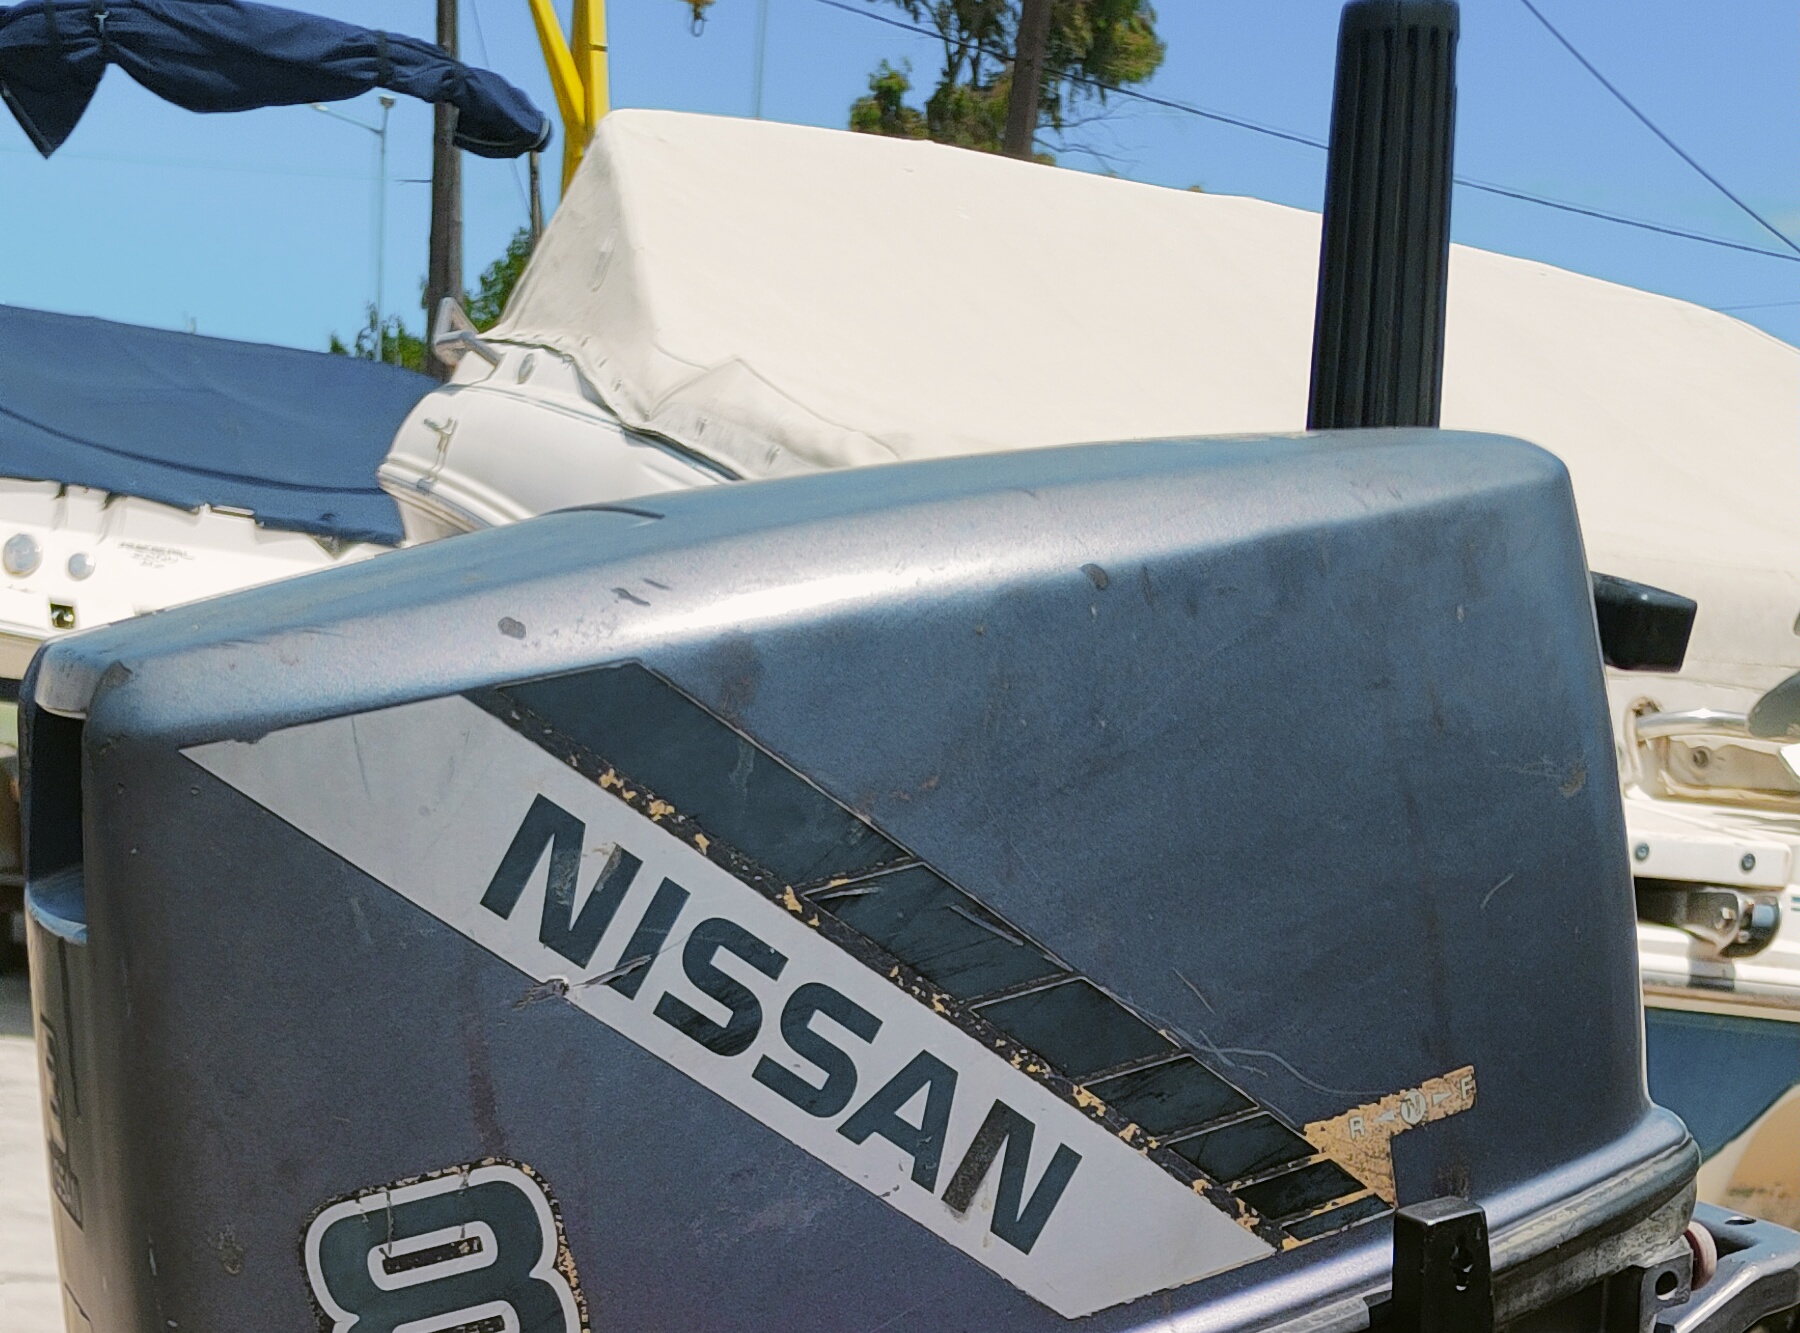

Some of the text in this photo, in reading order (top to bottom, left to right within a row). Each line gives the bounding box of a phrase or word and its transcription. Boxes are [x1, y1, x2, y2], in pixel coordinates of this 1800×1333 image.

[479, 793, 1083, 1256] NISSAN
[1349, 1115, 1365, 1140] R
[1460, 1073, 1474, 1099] F
